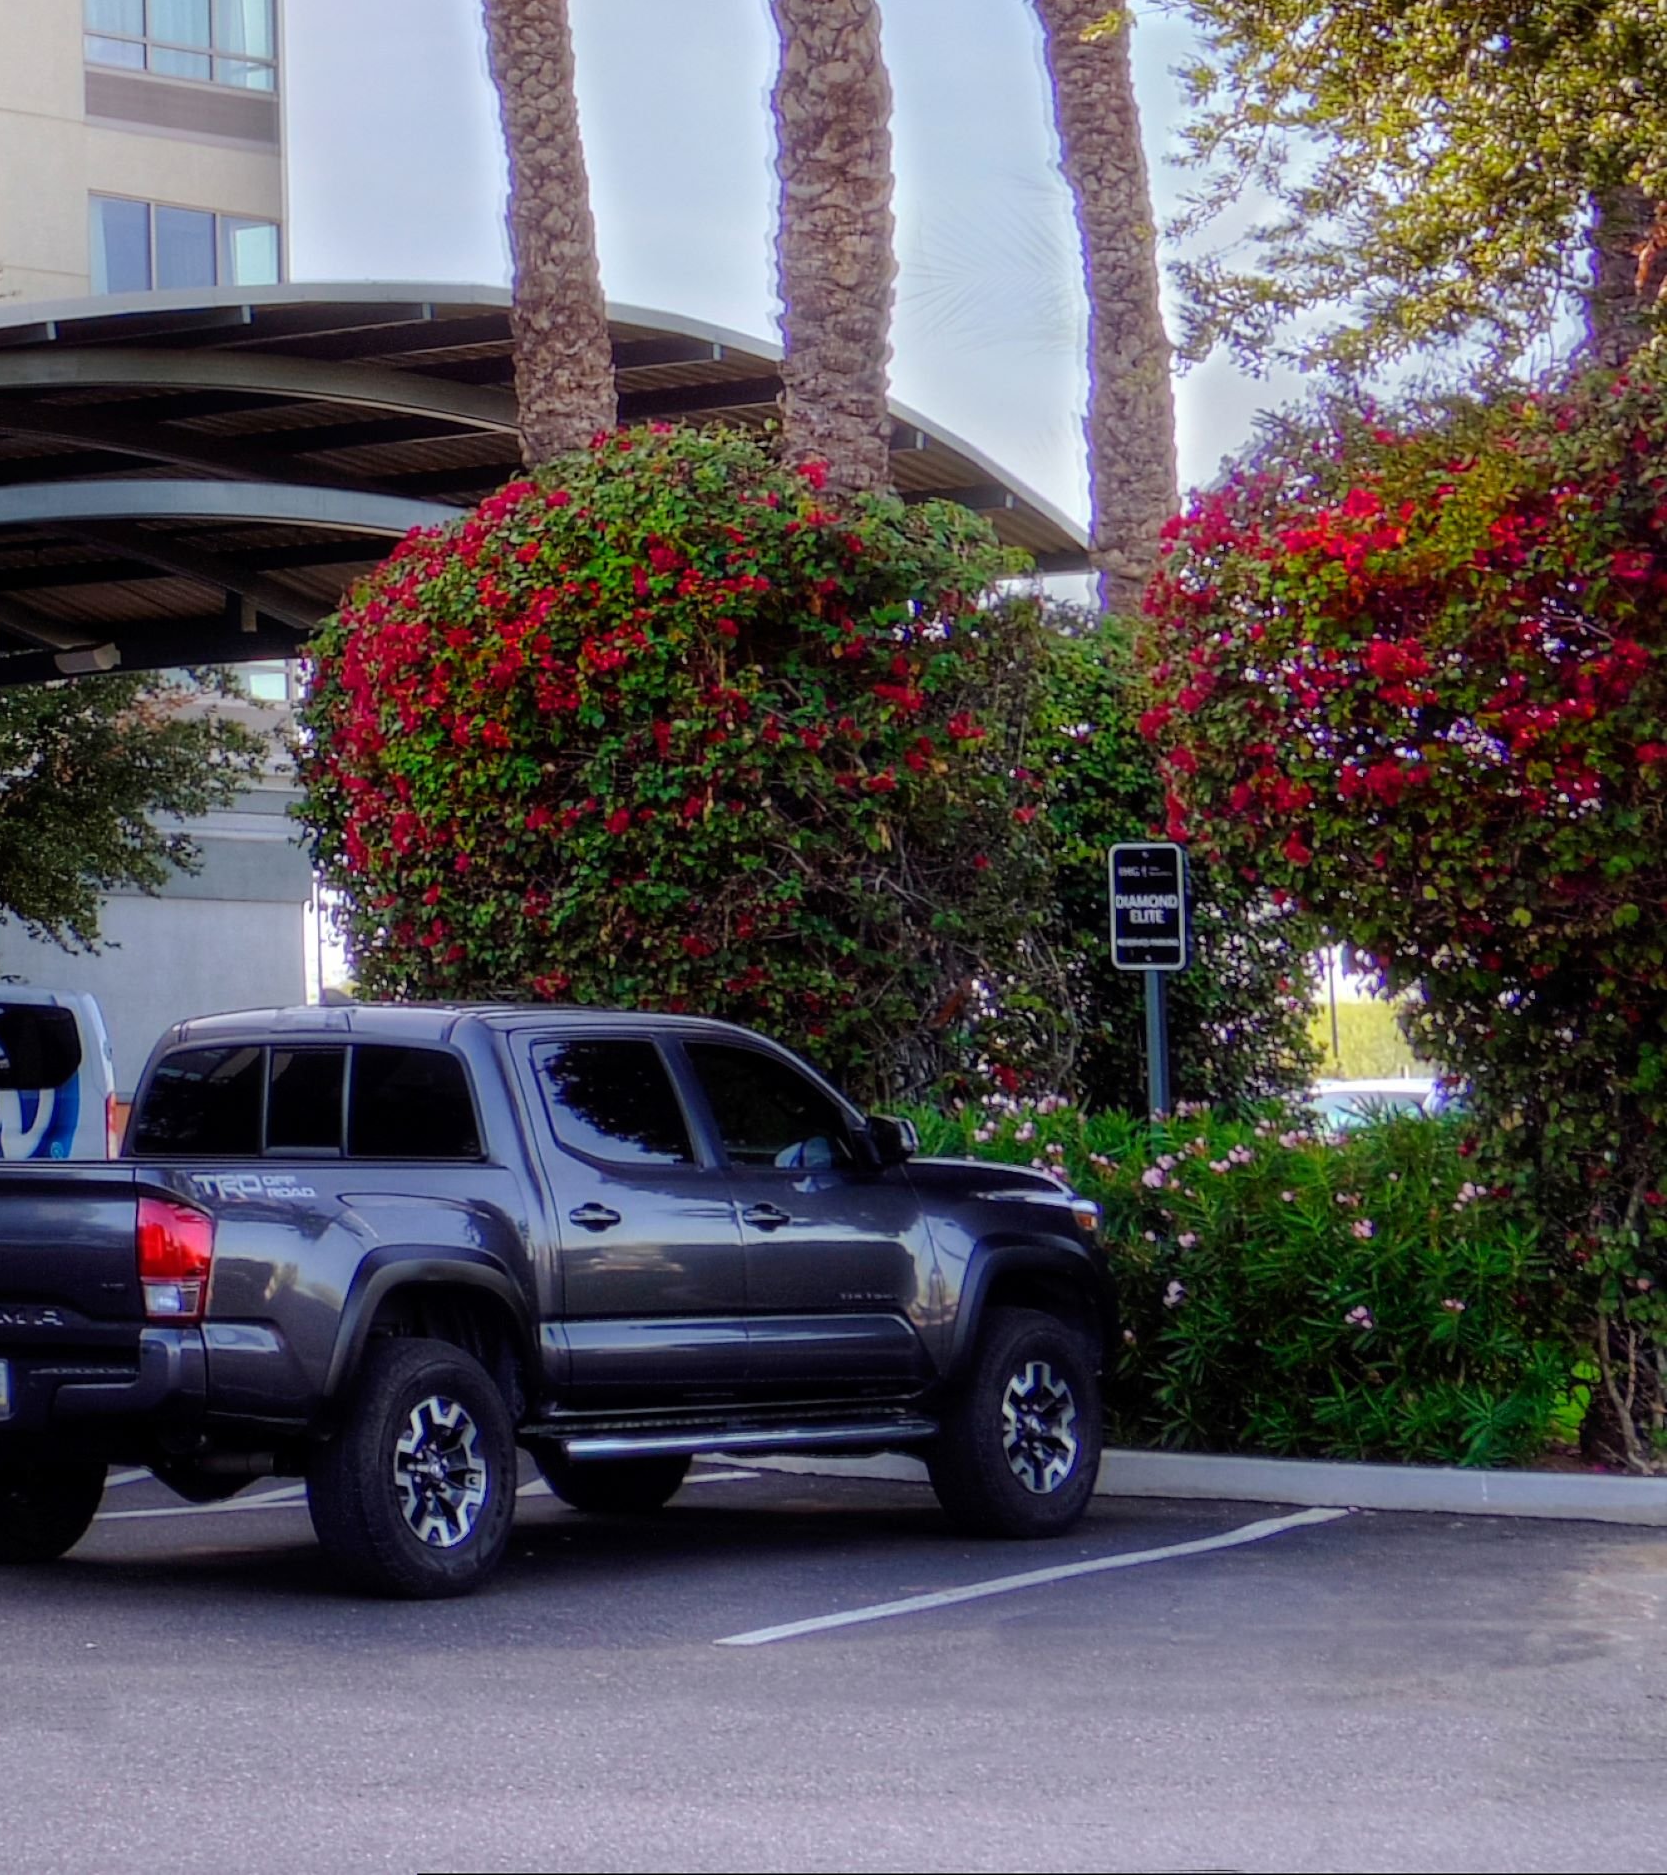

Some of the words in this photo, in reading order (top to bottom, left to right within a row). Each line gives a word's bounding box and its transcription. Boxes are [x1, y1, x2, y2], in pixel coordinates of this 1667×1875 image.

[1115, 893, 1179, 910] DIAMOND
[1129, 909, 1166, 924] ELITE
[191, 1174, 263, 1200] TRD
[267, 1186, 316, 1198] ROAD
